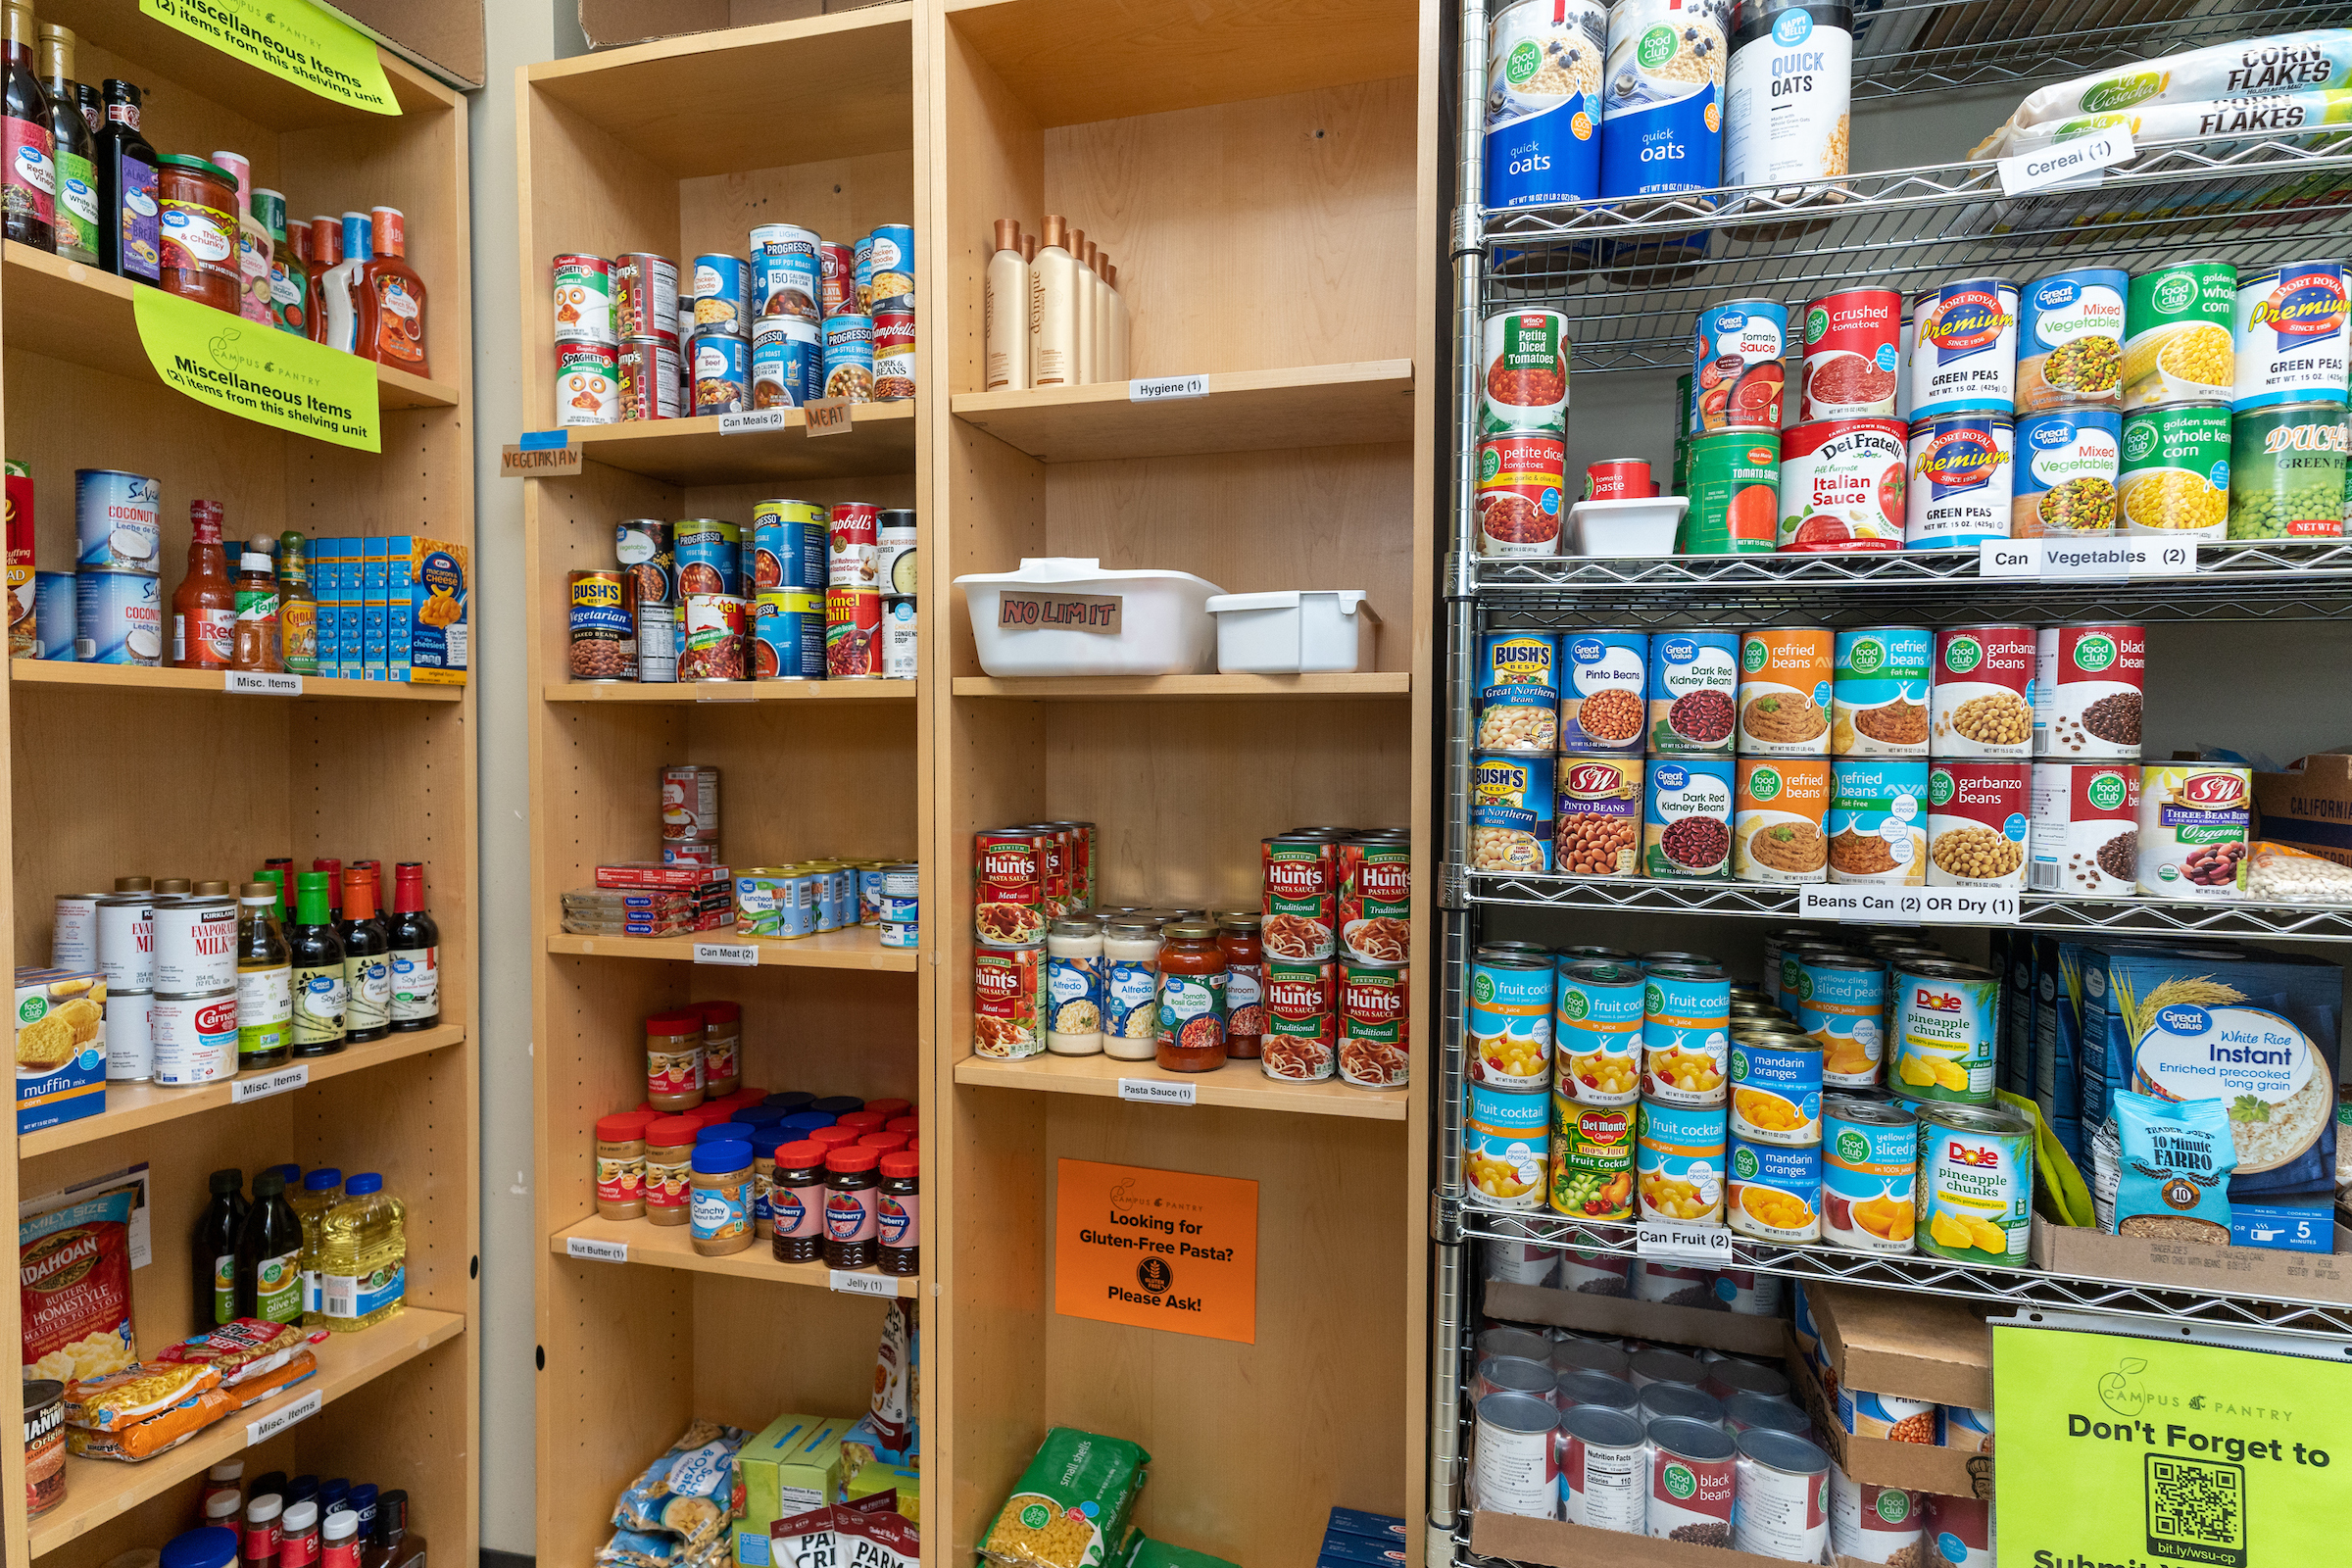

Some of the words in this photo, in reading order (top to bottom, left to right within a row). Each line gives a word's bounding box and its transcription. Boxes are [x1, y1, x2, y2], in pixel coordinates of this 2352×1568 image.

[279, 21, 323, 50] PANTRY
[1644, 33, 1671, 49] food
[180, 0, 307, 66] iscellaneous
[310, 55, 363, 89] Items
[1644, 44, 1668, 59] club
[179, 5, 221, 37] items
[223, 29, 260, 56] from
[262, 50, 289, 70] this
[292, 65, 352, 97] shelving
[354, 86, 385, 106] unit
[2241, 40, 2323, 69] CORN
[1771, 52, 1824, 76] QUICK
[2228, 59, 2332, 93] FLAKES
[1771, 75, 1813, 98] OATS
[1642, 128, 1674, 144] quick
[1641, 143, 1686, 163] oats
[2027, 150, 2084, 176] Cereal
[2088, 140, 2113, 162] (1)
[766, 242, 812, 255] PROGRESSO
[795, 261, 811, 270] ROAST
[771, 272, 788, 284] 150
[1833, 305, 1888, 321] crushed
[2083, 304, 2121, 317] Mixed
[1832, 319, 1880, 332] tomatoes
[2044, 317, 2121, 334] Vegetables
[1518, 330, 1546, 342] Petite
[1741, 333, 1776, 343] Tomato
[1519, 342, 1546, 353] Diced
[1740, 342, 1776, 354] Sauce
[212, 347, 260, 369] CAMPUS
[278, 367, 321, 387] PANTRY
[1508, 353, 1554, 365] Tomatoes
[1932, 371, 1968, 387] GREEN
[1972, 369, 1999, 381] PEAS
[173, 354, 303, 407] Miscellaneous
[307, 394, 353, 420] Items
[1140, 381, 1184, 397] Hygiene
[1186, 379, 1201, 394] (1)
[166, 368, 185, 385] (2)
[186, 375, 223, 398] items
[224, 389, 258, 409] from
[260, 400, 284, 416] this
[287, 409, 339, 433] shelving
[342, 424, 368, 438] unit
[722, 416, 740, 427] Can
[742, 415, 768, 425] Meals
[770, 413, 782, 424] (2)
[808, 407, 845, 427] MEAT
[1820, 437, 1852, 461] Dei
[1853, 433, 1901, 460] Fratelli
[503, 450, 578, 468] VEGETARIAN
[1595, 481, 1625, 495] paste
[1813, 474, 1871, 492] Italian
[1813, 492, 1866, 507] Sauce
[1994, 551, 2030, 566] Can
[2046, 549, 2147, 566] Vegetables
[2162, 548, 2187, 565] (2)
[573, 584, 619, 600] BUSH'S
[569, 610, 627, 623] Vegetarian
[1003, 600, 1038, 624] NO
[1041, 600, 1115, 626] LIMIT
[1494, 646, 1550, 664] BUSH'S
[1772, 644, 1815, 658] refried
[1690, 666, 1715, 676] Dark
[1717, 667, 1733, 676] Red
[1772, 656, 1810, 669] beans
[236, 676, 266, 688] Misc.
[269, 678, 297, 690] Items
[1586, 669, 1611, 680] Pinto
[1613, 670, 1641, 680] Beans
[1669, 676, 1704, 687] Kidney
[1706, 676, 1733, 686] Beans
[2181, 823, 2243, 844] Organic
[1806, 894, 1857, 909] Beans
[1862, 896, 1894, 910] Can
[1900, 897, 1922, 913] (2)
[1926, 897, 1954, 912] OR
[1958, 897, 1986, 914] Dry
[1991, 897, 2015, 914] (1)
[195, 936, 229, 956] MILK
[701, 947, 717, 956] Can
[719, 949, 740, 958] Meat
[742, 950, 754, 959] (2)
[1121, 985, 1152, 994] Alfredo
[1269, 985, 1324, 1006] Hunt's
[1275, 1022, 1315, 1032] Traditional
[2221, 1030, 2259, 1045] White
[2264, 1033, 2291, 1046] Rice
[2209, 1044, 2292, 1066] Instant
[2159, 1062, 2216, 1076] Enriched
[2219, 1067, 2291, 1080] precooked
[24, 1077, 71, 1098] muffin
[73, 1078, 86, 1088] mix
[242, 1077, 271, 1097] Misc.
[272, 1071, 303, 1089] Items
[2224, 1078, 2255, 1092] long
[2257, 1080, 2291, 1092] grain
[1124, 1086, 1149, 1097] Pasta
[1151, 1087, 1178, 1098] Sauce
[1179, 1089, 1191, 1100] (1)
[24, 1098, 42, 1108] corn
[1582, 1119, 1598, 1132] Del
[1598, 1119, 1627, 1132] Monte
[1765, 1152, 1813, 1165] mandarin
[2153, 1149, 2213, 1171] FARRO
[1765, 1164, 1806, 1177] oranges
[1938, 1167, 2008, 1188] pineapple
[1945, 1179, 1999, 1198] chunks
[693, 1205, 725, 1217] Crunchy
[1112, 1195, 1151, 1206] CAMPUS
[1165, 1201, 1203, 1212] PANTRY
[1109, 1210, 1175, 1235] Looking
[1179, 1219, 1203, 1235] for
[1079, 1229, 1175, 1254] Gluten-Free
[1180, 1242, 1234, 1262] Pasta?
[1639, 1231, 1667, 1244] Can
[1672, 1232, 1706, 1247] Fruit
[1710, 1235, 1730, 1250] (2)
[570, 1244, 586, 1254] Nut
[587, 1245, 612, 1257] Butter
[612, 1248, 624, 1259] (1)
[20, 1237, 98, 1287] IDAHOAN
[847, 1277, 868, 1291] Jelly
[870, 1279, 882, 1292] (1)
[1144, 1277, 1165, 1286] GLUTEN
[32, 1284, 110, 1325] HOMESTYLE
[1107, 1286, 1161, 1306] Please
[1165, 1295, 1202, 1312] Ask!
[2103, 1388, 2180, 1409] CAMPUS
[2214, 1401, 2293, 1422] PANTRY
[258, 1417, 284, 1436] Misc.
[288, 1400, 316, 1418] Items
[2068, 1413, 2156, 1446] Don't
[2167, 1425, 2283, 1463] Forget
[2292, 1442, 2330, 1468] to
[1059, 1461, 1079, 1488] small
[1072, 1439, 1092, 1463] shells
[1587, 1449, 1615, 1461] Nutrition
[1699, 1473, 1730, 1488] black
[1699, 1489, 1731, 1501] beans
[2157, 1542, 2237, 1566] bit.ly/wsu-cp
